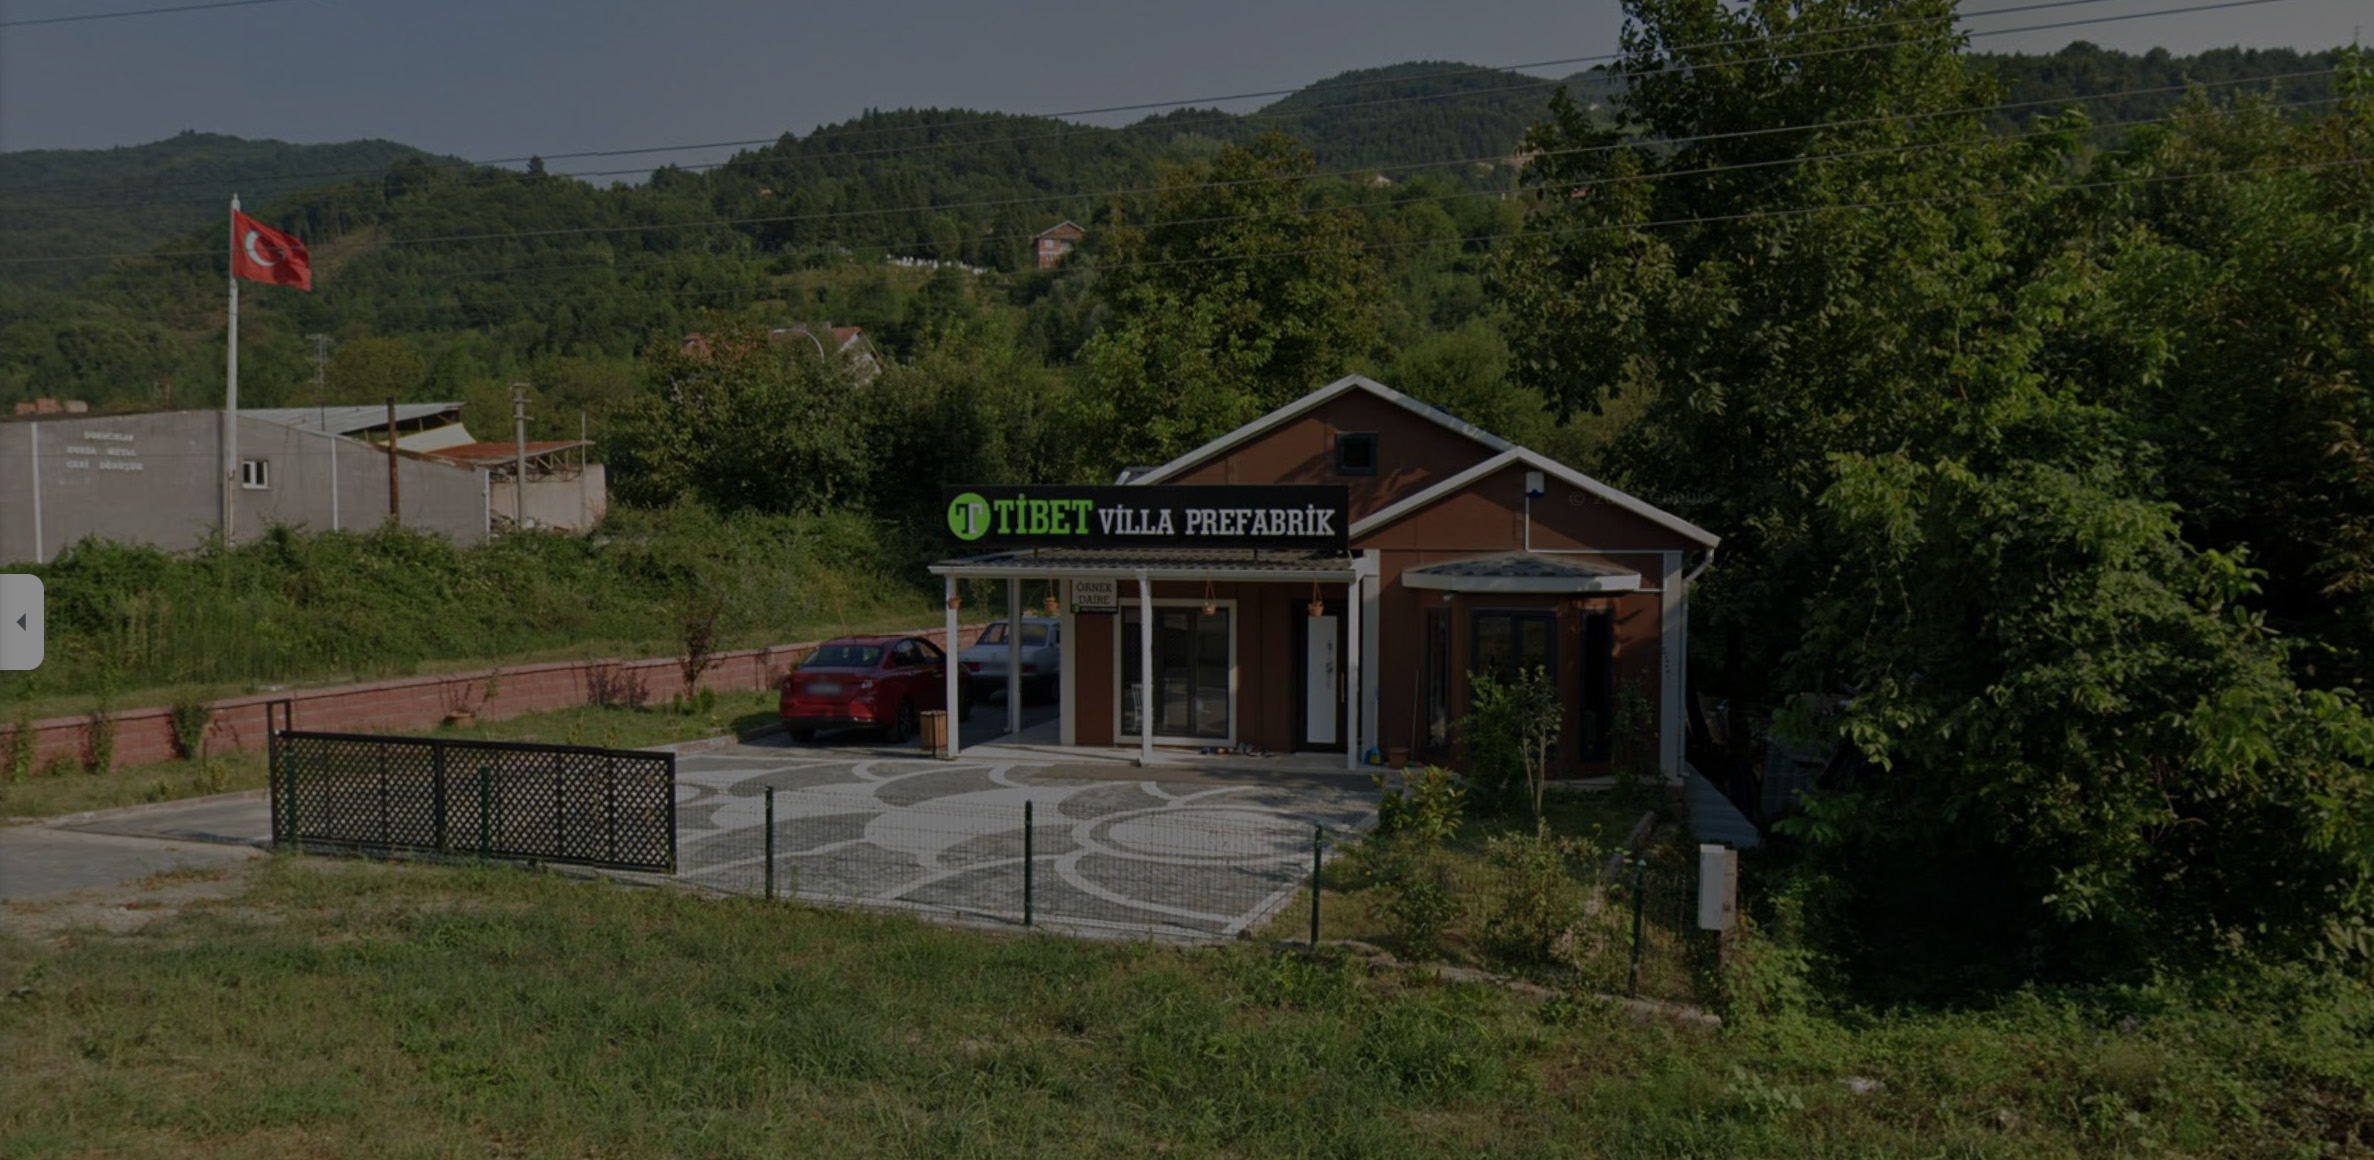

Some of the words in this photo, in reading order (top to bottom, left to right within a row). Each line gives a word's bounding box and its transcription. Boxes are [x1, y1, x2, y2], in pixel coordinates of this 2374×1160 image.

[993, 493, 1093, 534] TİBET
[1098, 504, 1175, 535] VİLLA
[1185, 504, 1336, 535] PREFABRİK
[1076, 580, 1112, 592] ÖRNEK
